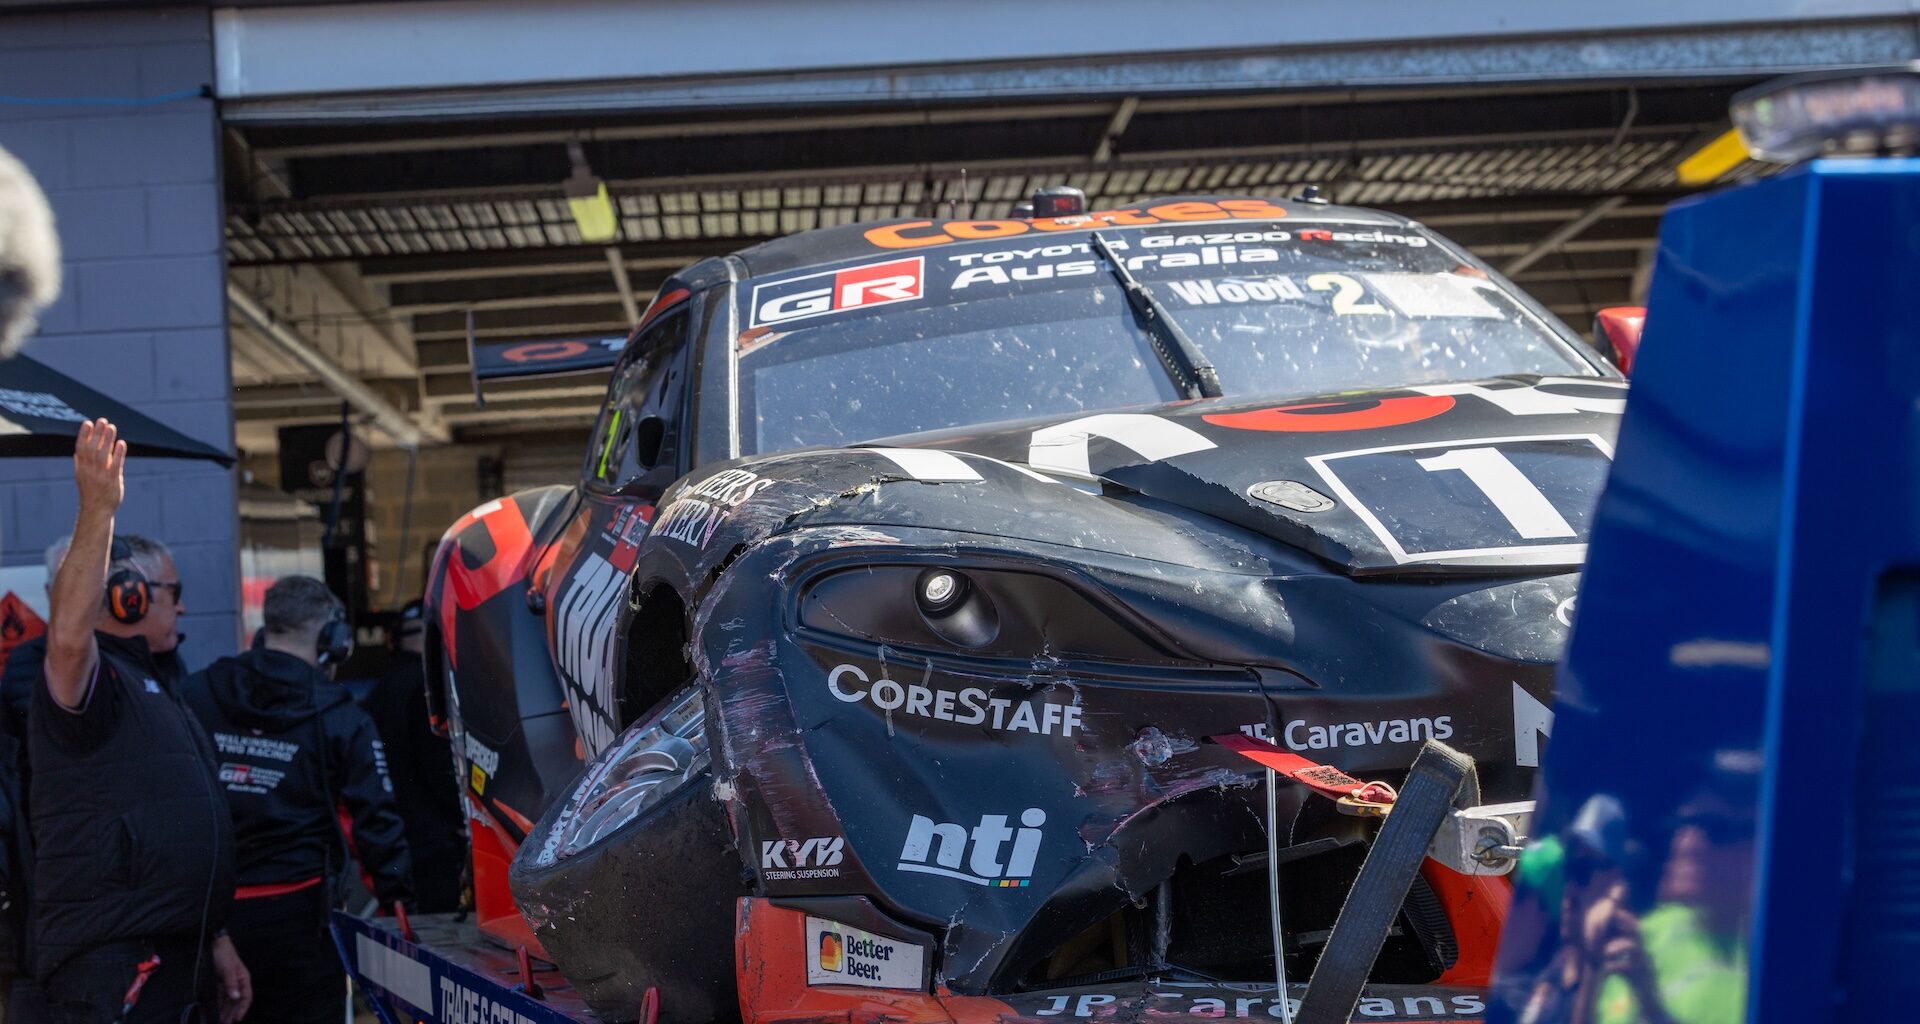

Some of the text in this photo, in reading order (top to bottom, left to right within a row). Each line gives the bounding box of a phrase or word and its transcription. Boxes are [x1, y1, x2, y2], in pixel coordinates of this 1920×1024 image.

[864, 200, 1288, 249] Coates
[948, 230, 1428, 267] TOYOTA GAZOO Racing
[758, 271, 922, 320] GR
[1167, 272, 1388, 316] Wood 2
[1284, 716, 1454, 750] Caravans
[761, 836, 845, 869] KYB
[898, 807, 1047, 879] nti
[765, 868, 840, 880] STEERING SUSPENSION
[846, 934, 894, 963] Better
[1144, 991, 1487, 1020] Caraans
